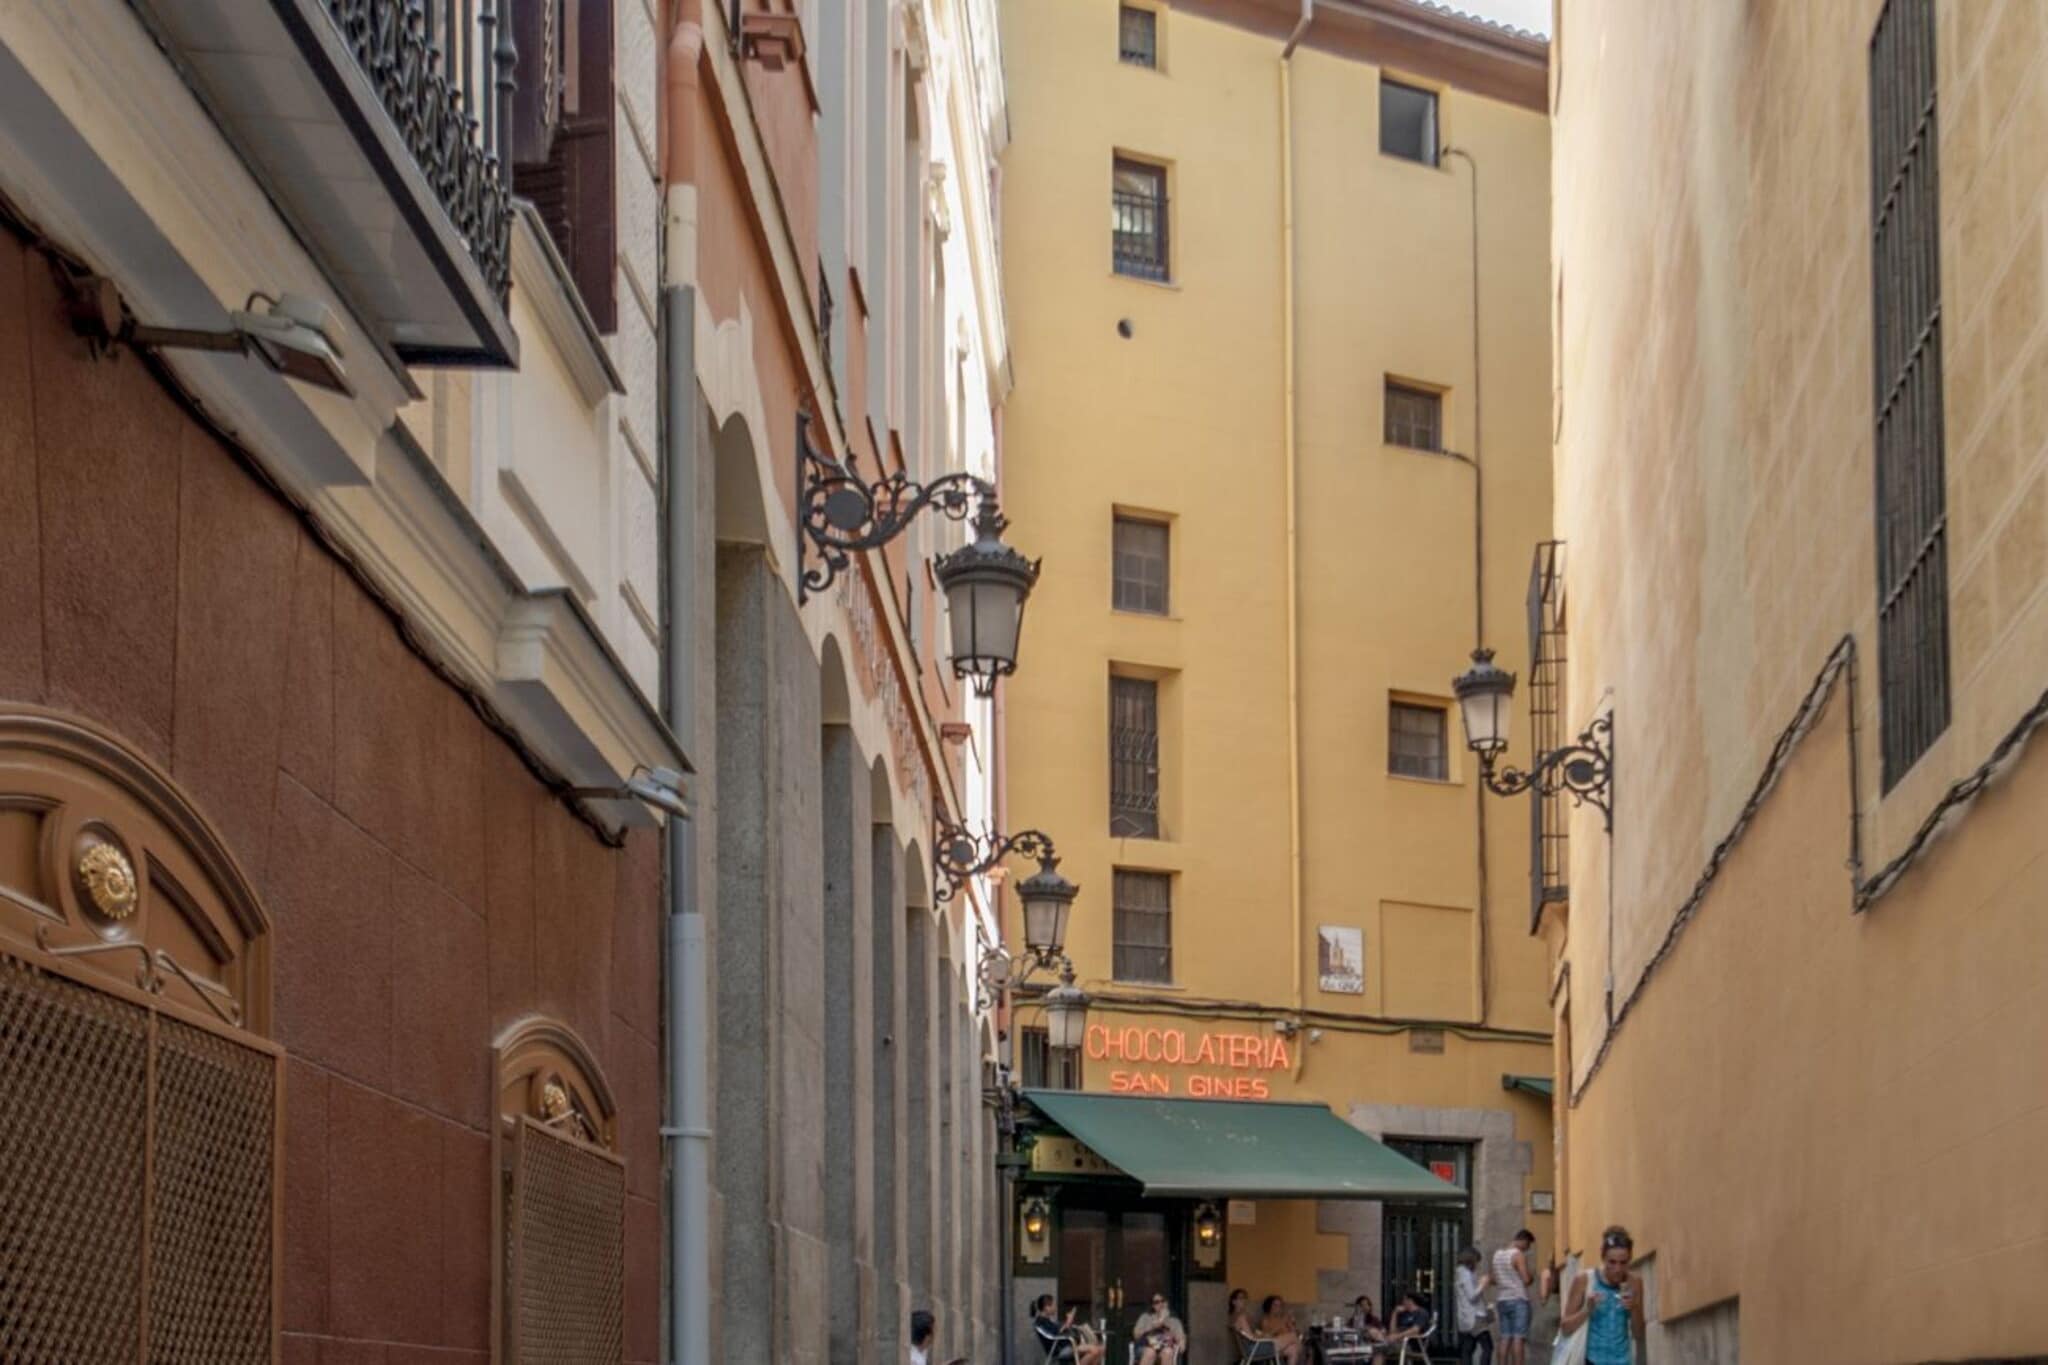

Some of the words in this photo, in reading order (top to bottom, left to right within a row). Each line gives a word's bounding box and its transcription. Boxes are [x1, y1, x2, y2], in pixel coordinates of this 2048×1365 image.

[1087, 1024, 1289, 1069] CHOCOLATERIA
[1110, 1070, 1169, 1093] SAN
[1188, 1074, 1268, 1098] GINES
